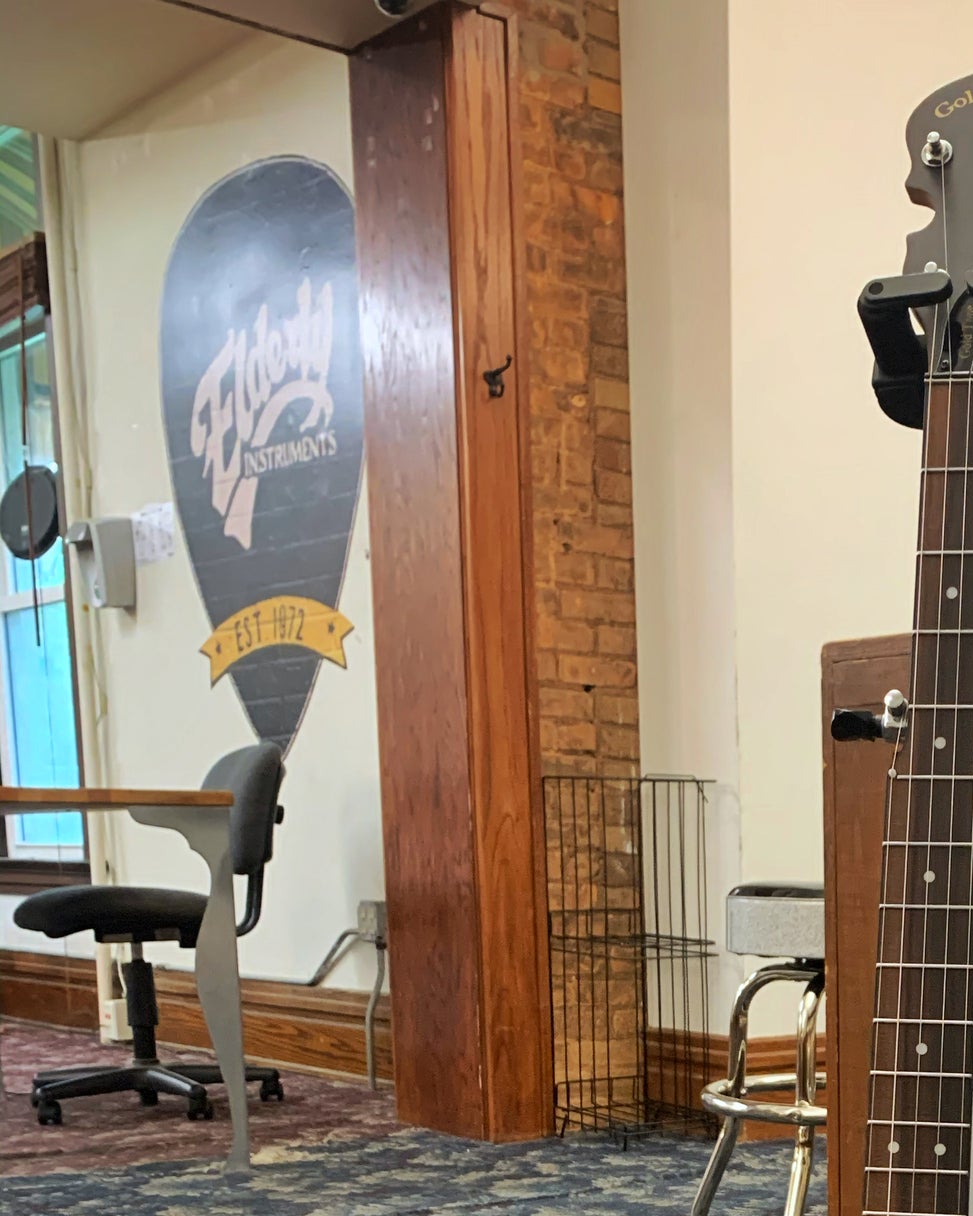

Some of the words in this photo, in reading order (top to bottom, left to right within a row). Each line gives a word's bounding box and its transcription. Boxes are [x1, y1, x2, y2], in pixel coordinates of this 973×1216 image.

[190, 276, 334, 549] Elderly
[244, 429, 338, 478] INSTRUMENTS
[273, 604, 305, 641] 1972
